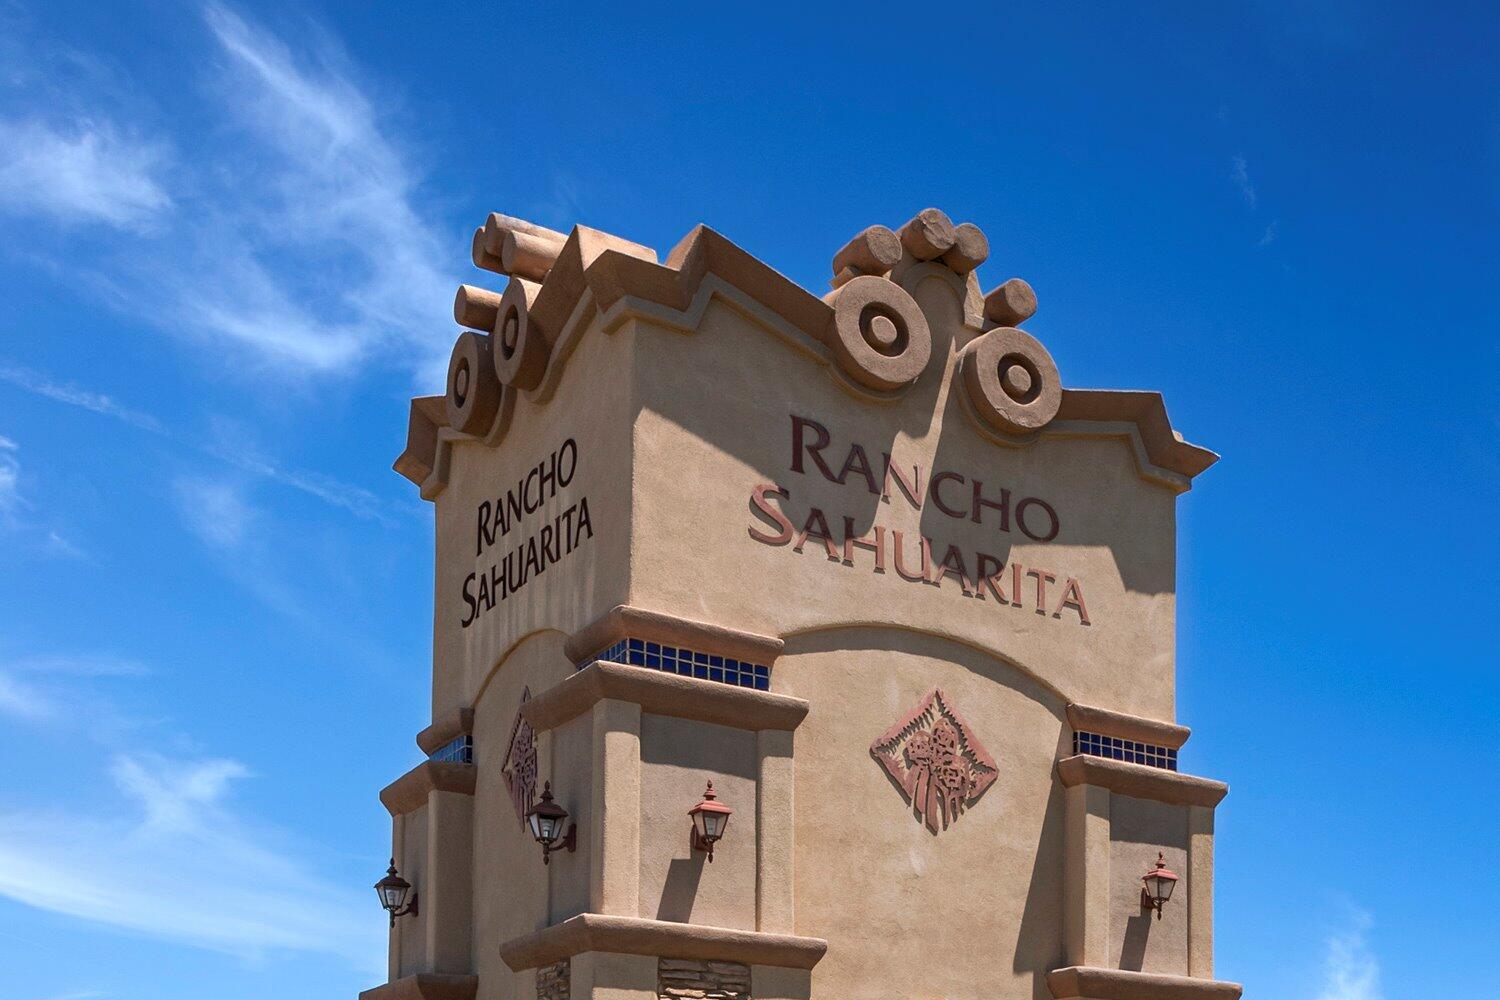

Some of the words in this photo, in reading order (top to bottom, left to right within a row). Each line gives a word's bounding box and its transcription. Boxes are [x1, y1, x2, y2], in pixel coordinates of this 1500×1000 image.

[477, 438, 578, 557] RANCHO
[789, 414, 1060, 543] RANCHO
[461, 496, 594, 629] SAHUARITA
[748, 483, 1092, 627] SAHUARITA
